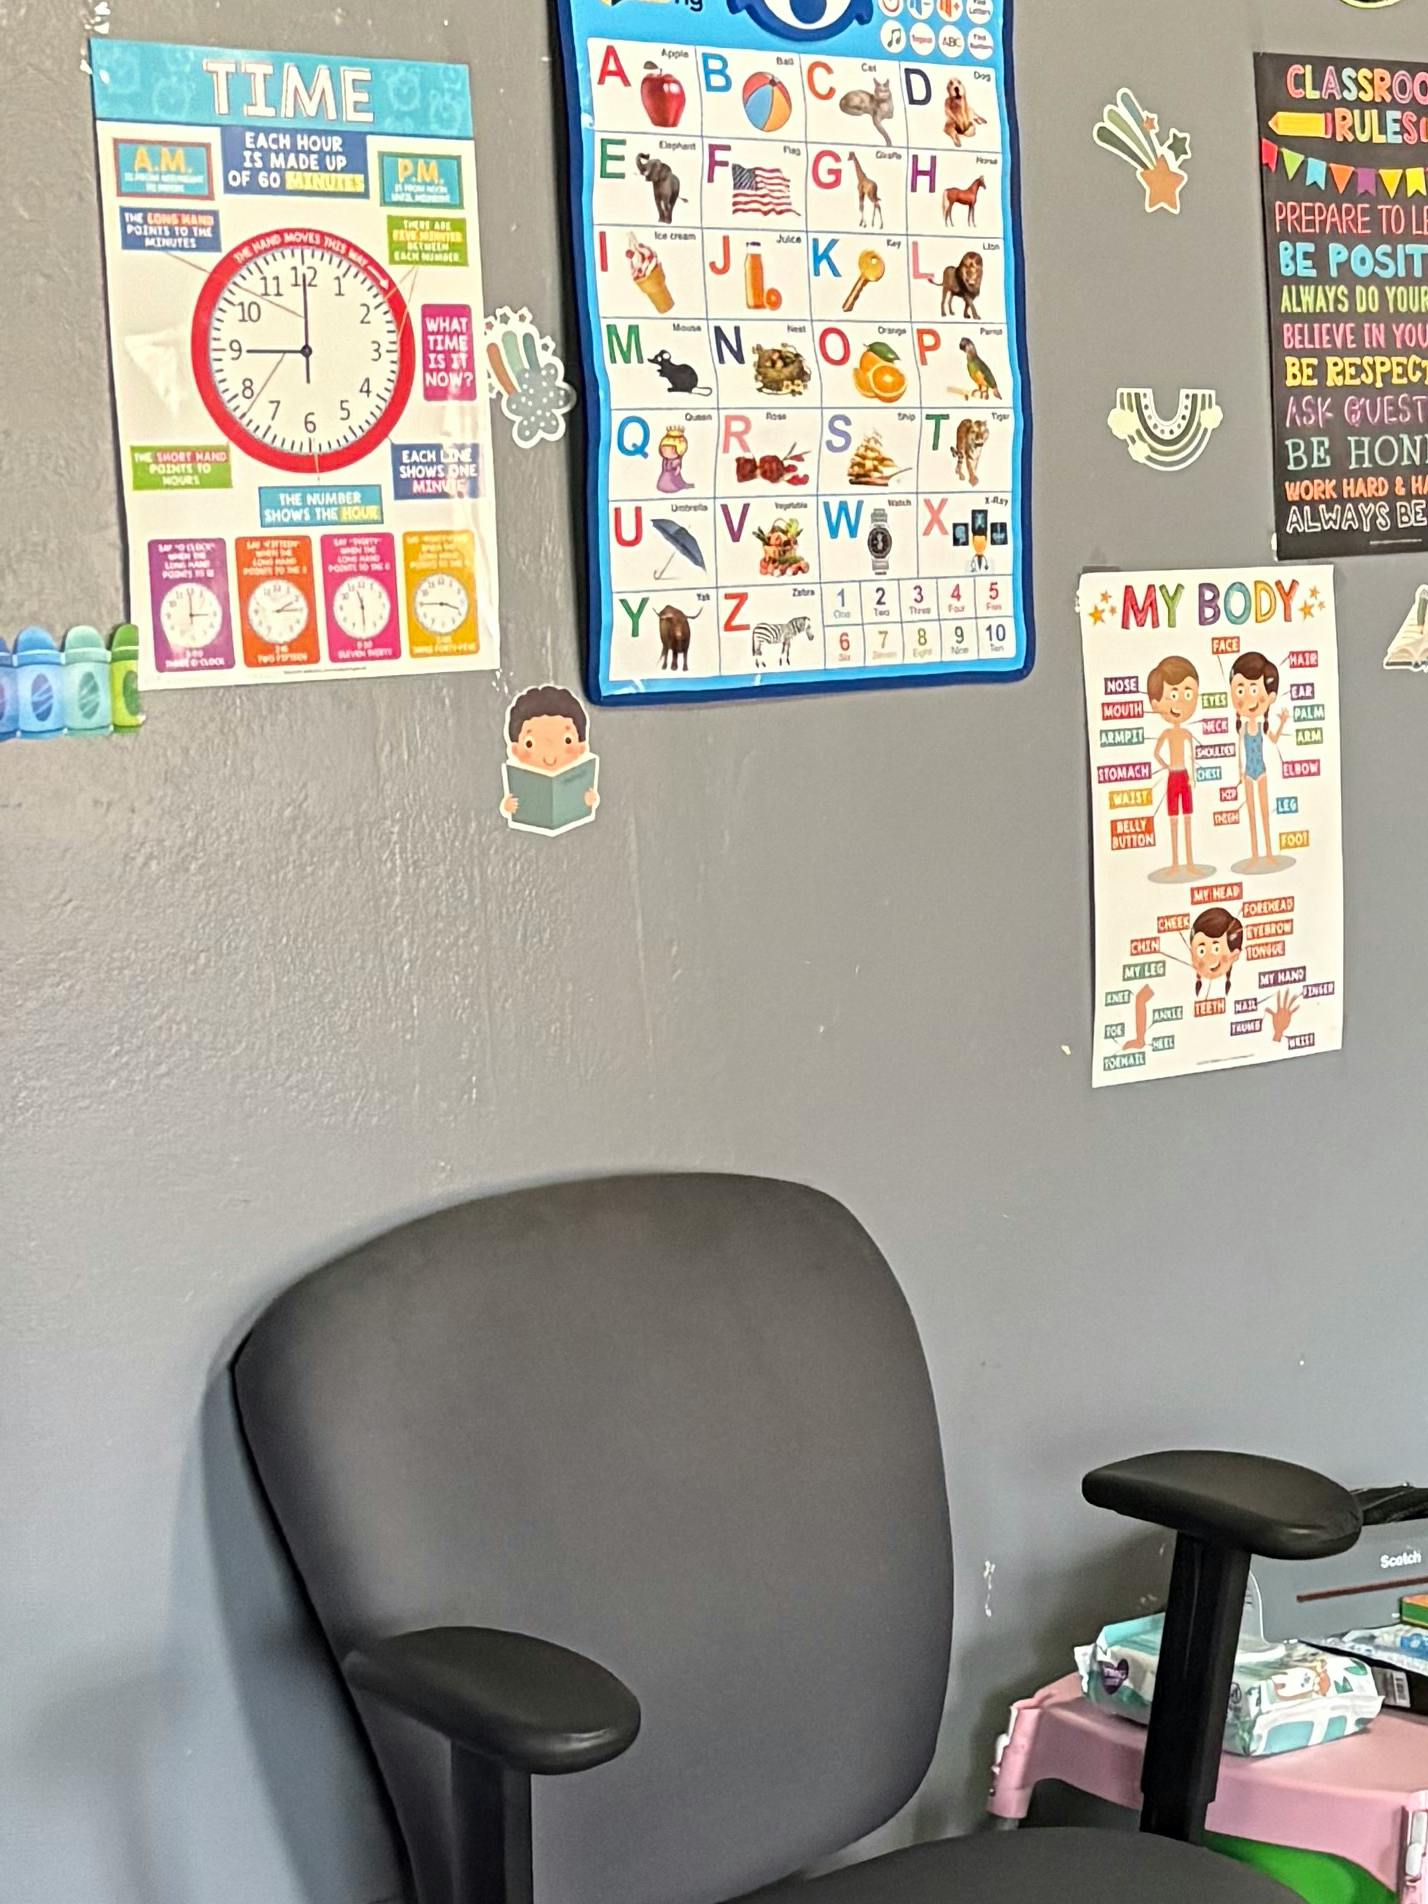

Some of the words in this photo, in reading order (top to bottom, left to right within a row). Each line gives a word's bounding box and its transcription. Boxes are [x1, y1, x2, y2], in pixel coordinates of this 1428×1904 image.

[597, 45, 631, 86] A
[702, 53, 732, 92] B
[202, 59, 375, 123] TIME
[807, 62, 836, 101] C
[904, 68, 931, 105] D
[1334, 108, 1418, 144] RULES
[245, 132, 291, 150] EACH
[296, 134, 342, 153] HOUR
[134, 146, 193, 173] A.M.
[242, 151, 264, 167] IS
[270, 154, 319, 170] MADE
[325, 155, 347, 170] UP
[600, 139, 626, 179] E
[707, 145, 732, 183] F
[812, 150, 842, 189] G
[228, 173, 252, 188] OF
[258, 173, 280, 189] 60
[398, 159, 444, 185] P.M.
[910, 155, 936, 193] H
[1275, 201, 1371, 234] PREPARE
[1378, 204, 1405, 235] TO
[599, 231, 608, 272] I
[709, 235, 729, 275] J
[812, 239, 842, 278] K
[912, 241, 934, 279] L
[1279, 241, 1317, 278] BE
[261, 276, 284, 297] 11
[291, 266, 318, 288] 12
[334, 276, 345, 297] 1
[1280, 285, 1349, 314] ALWAYS
[1356, 285, 1379, 313] DO
[237, 301, 261, 323] 10
[360, 303, 372, 325] 2
[425, 317, 468, 333] WHAT
[1283, 323, 1356, 349] BELIEVE
[1364, 323, 1385, 348] IN
[229, 339, 242, 360] 9
[371, 341, 381, 362] 3
[428, 336, 468, 350] TIME
[606, 324, 643, 364] M
[714, 326, 745, 364] N
[819, 327, 850, 365] O
[917, 329, 941, 365] P
[428, 353, 446, 369] IS
[451, 353, 468, 368] IT
[1285, 356, 1317, 387] BE
[242, 378, 254, 399] 8
[359, 378, 372, 398] 4
[425, 371, 473, 388] NOW?
[268, 400, 282, 421] 7
[340, 400, 350, 420] 5
[1285, 396, 1333, 428] ASK
[304, 413, 316, 433] 6
[722, 415, 752, 453] R
[825, 415, 852, 453] S
[925, 414, 949, 451] T
[617, 416, 650, 459] Q
[1285, 436, 1331, 470] BE
[279, 492, 303, 505] THE
[306, 492, 362, 505] NUMBER
[1285, 479, 1337, 501] WORK
[1343, 477, 1388, 498] HARD
[1395, 476, 1405, 495] &
[614, 507, 642, 546] U
[720, 503, 751, 542] V
[823, 501, 864, 539] W
[923, 499, 949, 536] X
[1286, 501, 1390, 533] ALWAYS
[1397, 500, 1427, 528] BE
[838, 589, 845, 608] 1
[876, 588, 886, 605] 2
[913, 585, 923, 603] 3
[951, 584, 961, 602] 4
[989, 583, 999, 600] 5
[724, 593, 750, 631] Z
[1121, 584, 1185, 629] MY
[1198, 579, 1299, 626] BODY
[619, 598, 649, 637] Y
[839, 633, 849, 651] 6
[878, 631, 888, 649] 7
[917, 629, 928, 646] 8
[954, 626, 964, 644] 9
[986, 624, 1006, 642] 10
[1213, 639, 1239, 653] FACE
[1290, 653, 1318, 666] HAIR
[1107, 678, 1137, 693] NOSE
[1291, 686, 1313, 698] EAR
[1104, 703, 1143, 718] MOUTH
[1295, 707, 1324, 720] PALM
[1297, 730, 1321, 742] ARM
[1283, 763, 1319, 776] ELBOW
[1131, 941, 1160, 954] CHIN
[1381, 1551, 1422, 1569] Scotch
